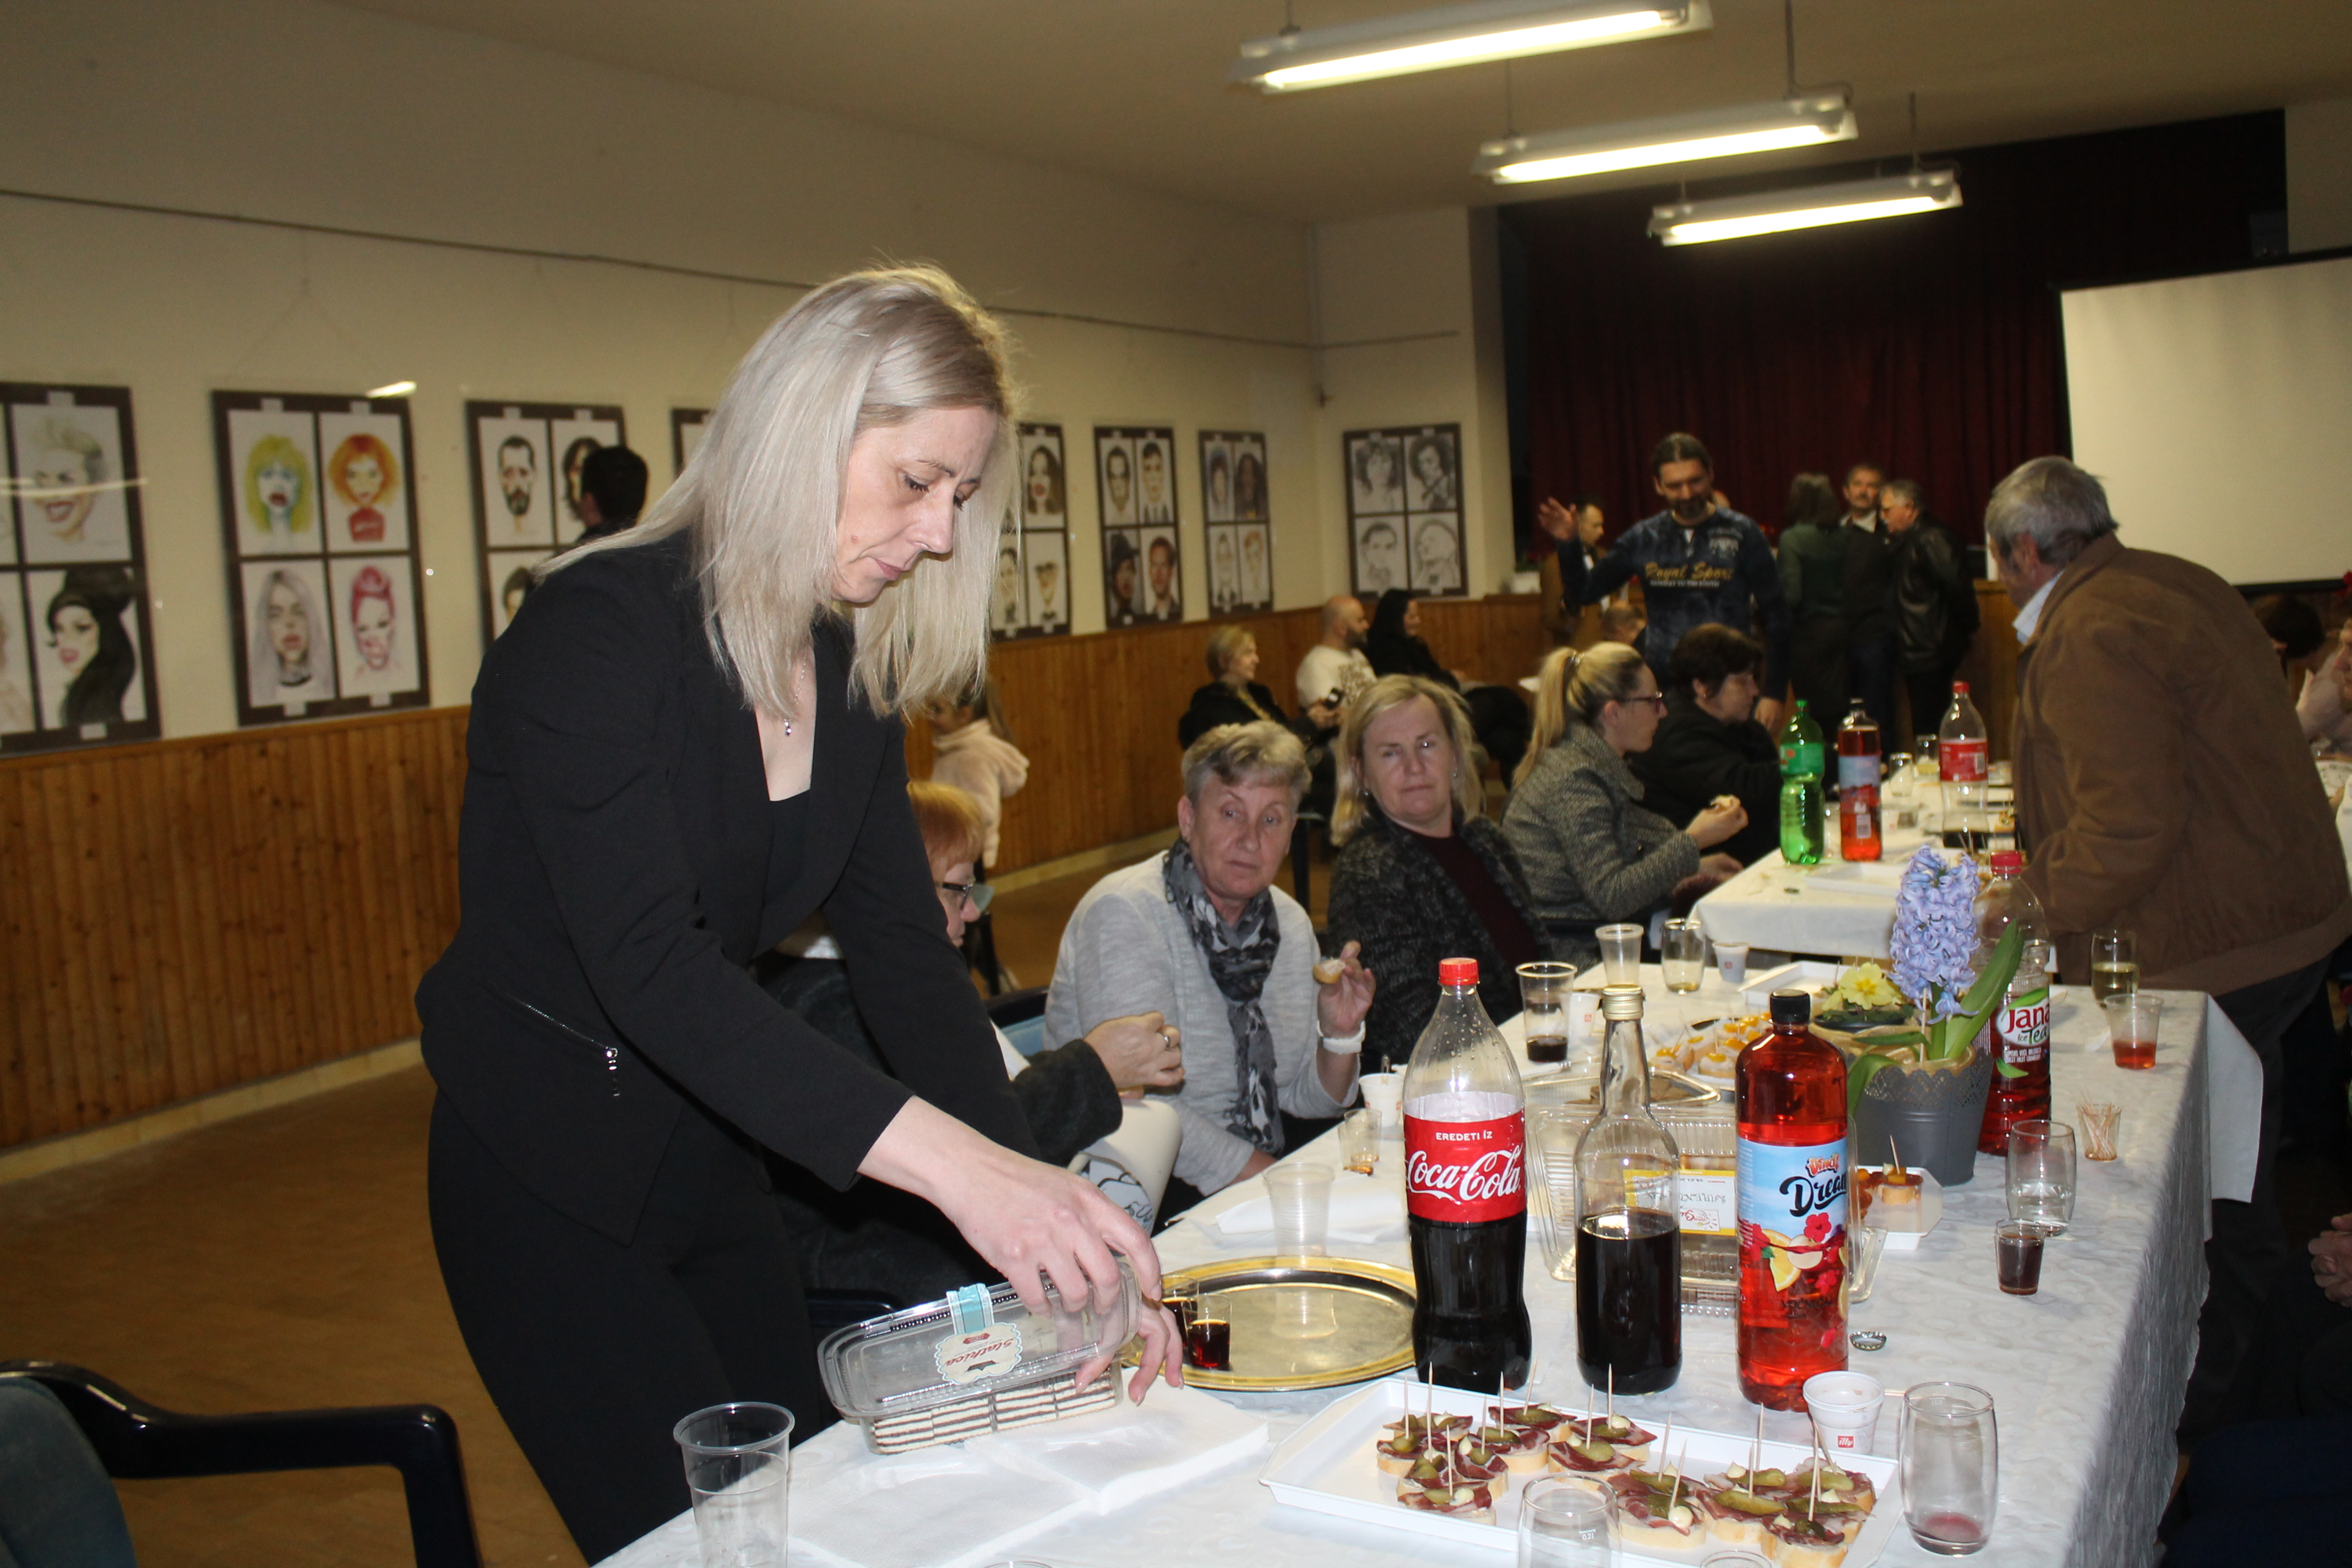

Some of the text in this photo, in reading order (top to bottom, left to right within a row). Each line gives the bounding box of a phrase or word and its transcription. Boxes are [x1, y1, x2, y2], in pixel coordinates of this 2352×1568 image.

[2003, 1004, 2050, 1033] Jana
[2017, 1021, 2047, 1045] Ice Tea
[1435, 1130, 1493, 1141] EREDETI ÍZ
[1408, 1142, 1523, 1205] Coca-Cola
[943, 1338, 1014, 1367] Slatkica
[1839, 1437, 1853, 1447] illy
